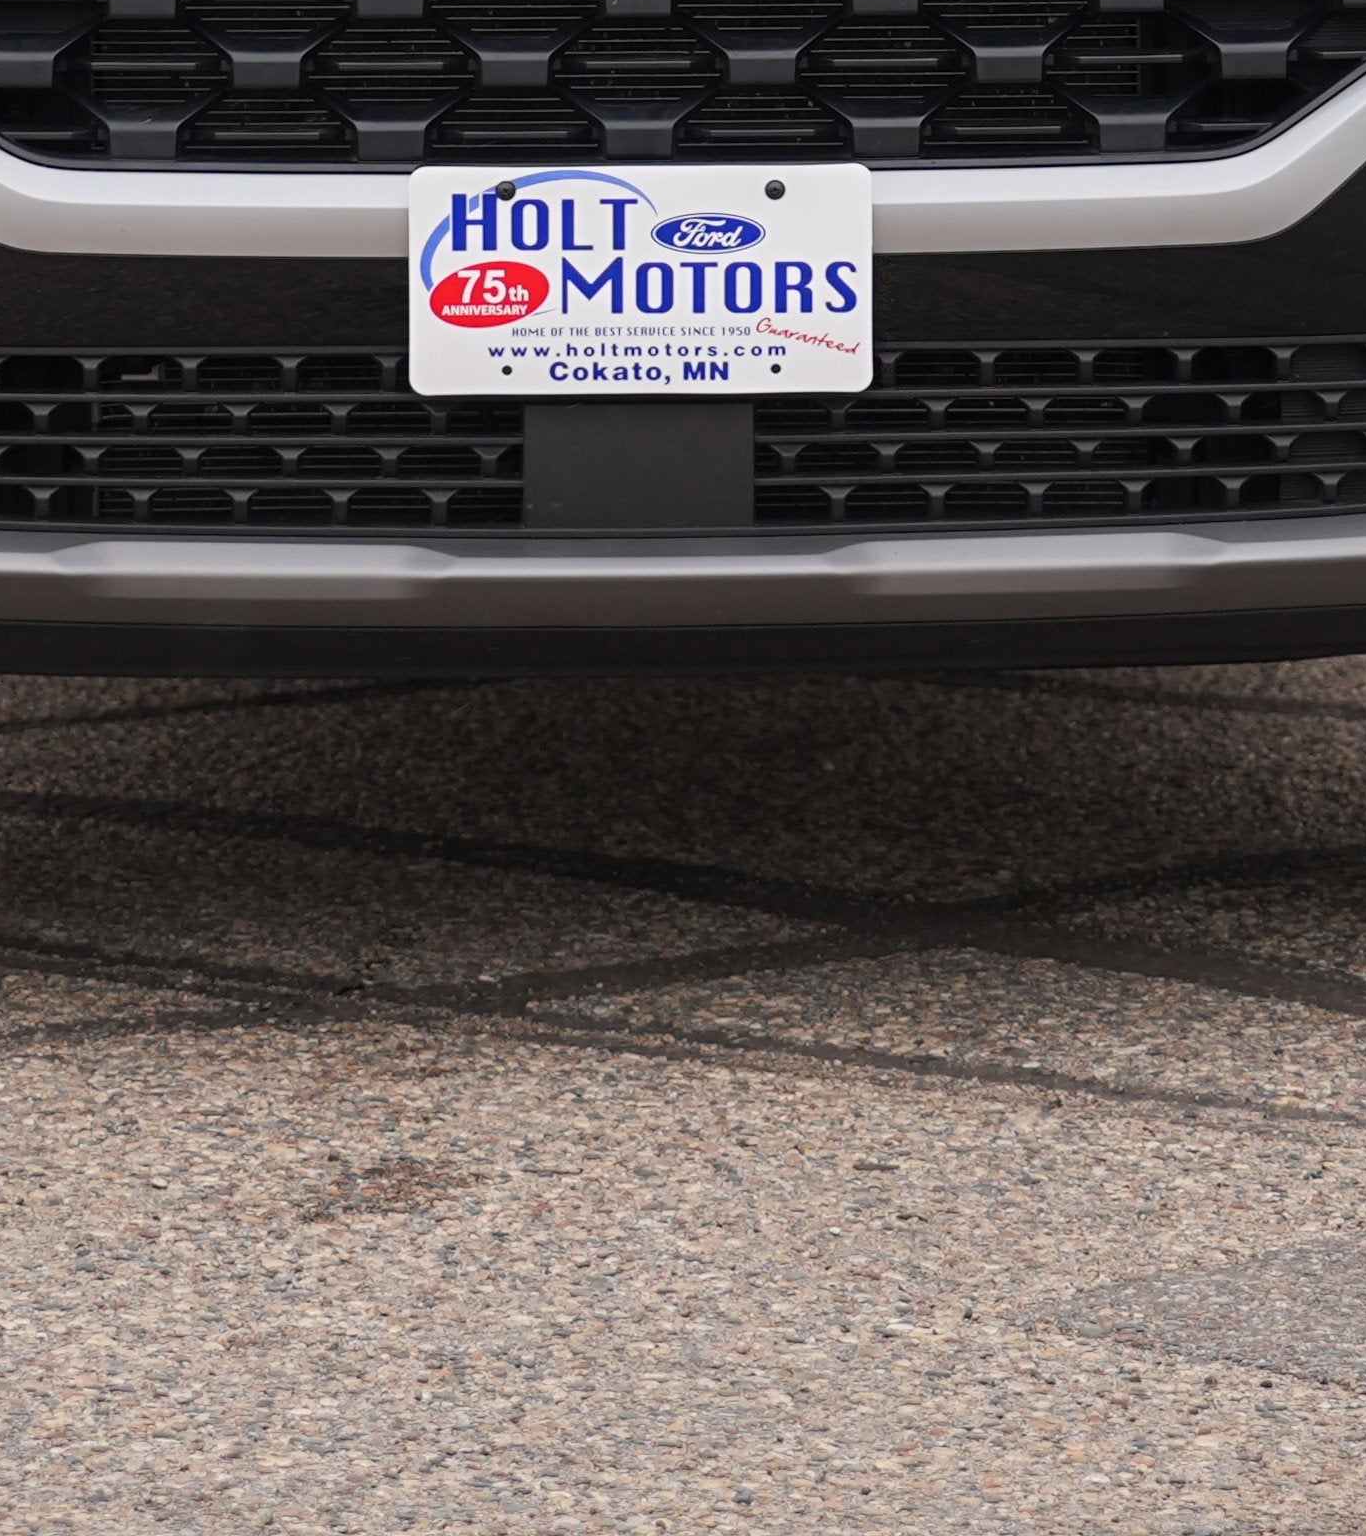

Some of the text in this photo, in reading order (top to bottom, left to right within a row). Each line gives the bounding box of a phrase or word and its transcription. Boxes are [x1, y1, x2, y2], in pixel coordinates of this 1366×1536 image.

[450, 193, 639, 252] HOLT
[672, 217, 744, 248] Ford
[457, 269, 530, 304] 75th
[561, 256, 858, 314] MOTORS
[441, 304, 528, 316] ANNIVERSARY
[512, 327, 751, 337] HOME OF THE BEST SERVICE SINCE 1950
[756, 317, 860, 355] Guaranteed
[488, 343, 786, 357] www.holtmotors.com
[549, 362, 729, 384] Cokato, MN
